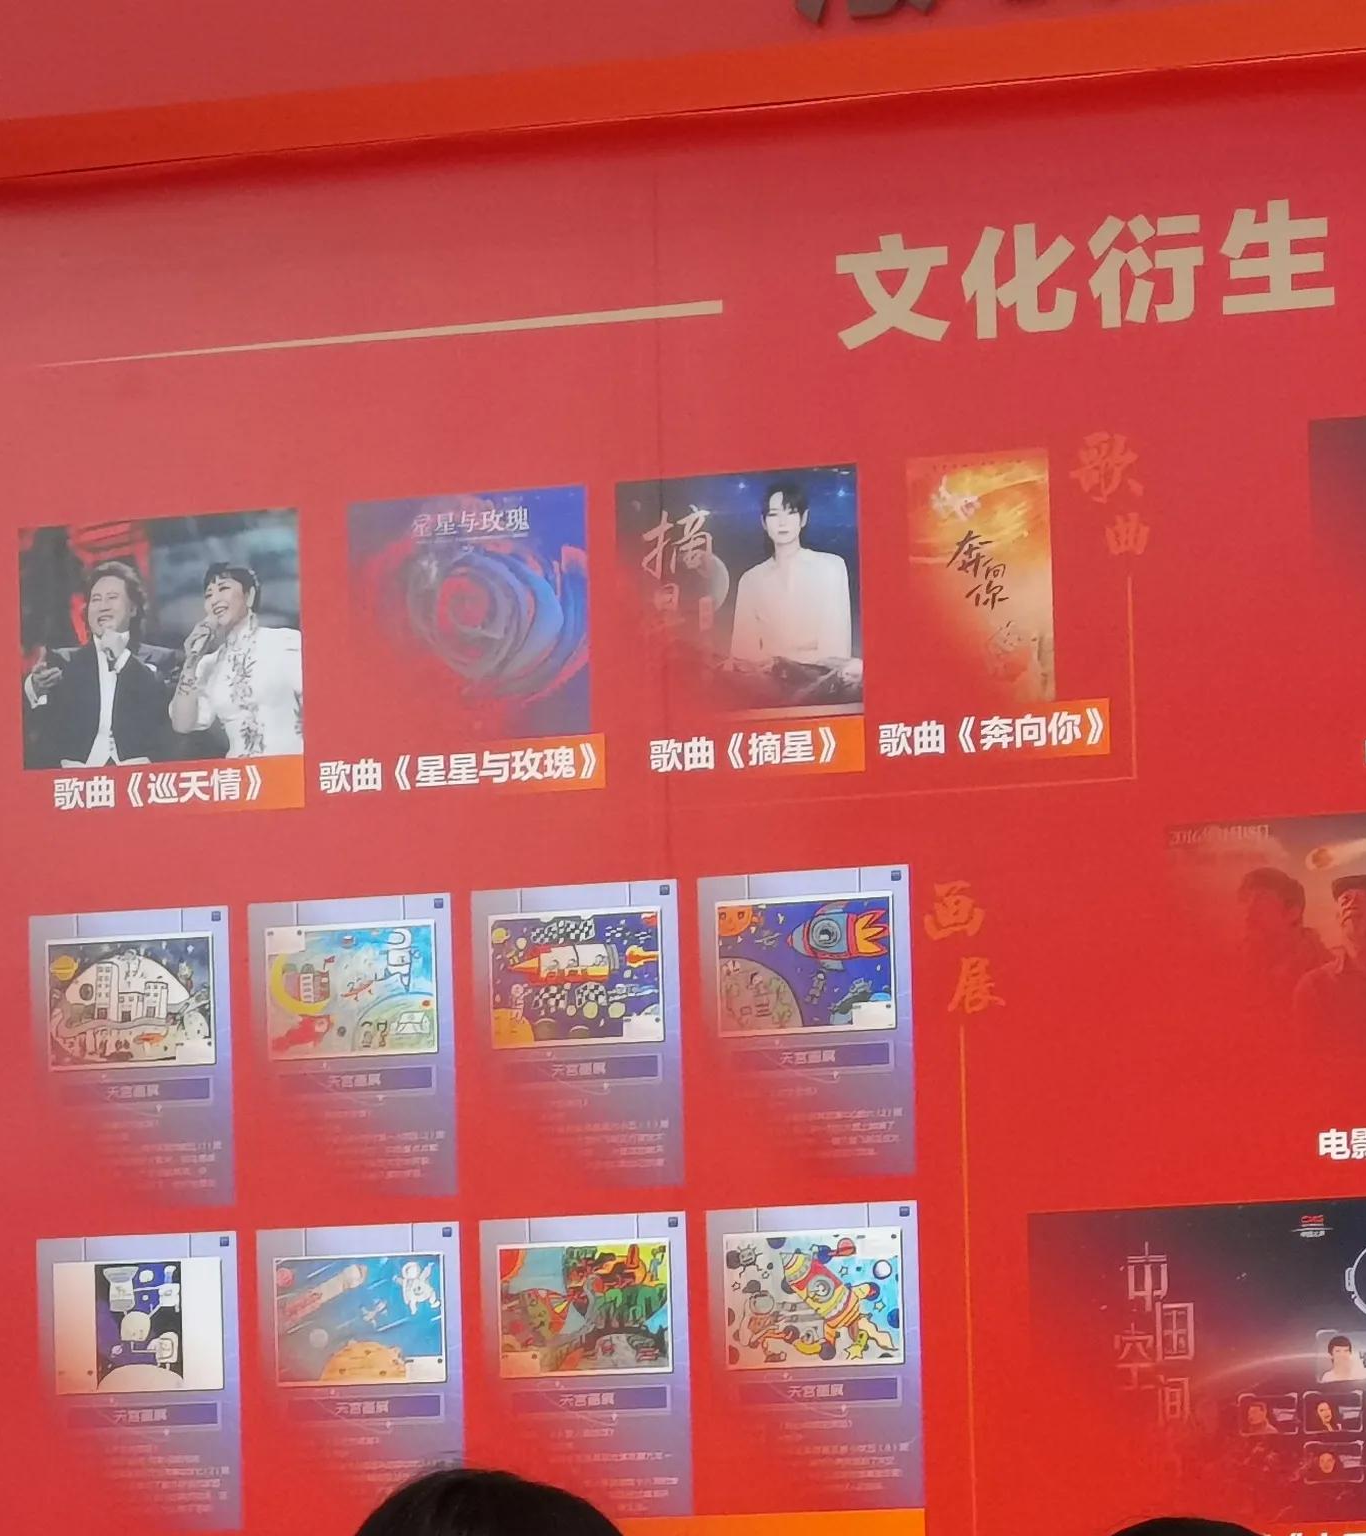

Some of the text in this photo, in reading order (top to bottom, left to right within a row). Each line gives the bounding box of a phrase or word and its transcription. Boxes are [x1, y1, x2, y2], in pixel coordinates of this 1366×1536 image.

[835, 198, 1336, 350] 文化衍生
[1069, 430, 1150, 559] 歌曲
[649, 725, 837, 774] 歌曲《摘星》
[878, 706, 1106, 758] 歌曲《奔向你》
[53, 765, 263, 810] 歌曲《巡天情》
[319, 743, 598, 795] 歌曲《星星与玫瑰》
[923, 879, 1007, 1015] 画展
